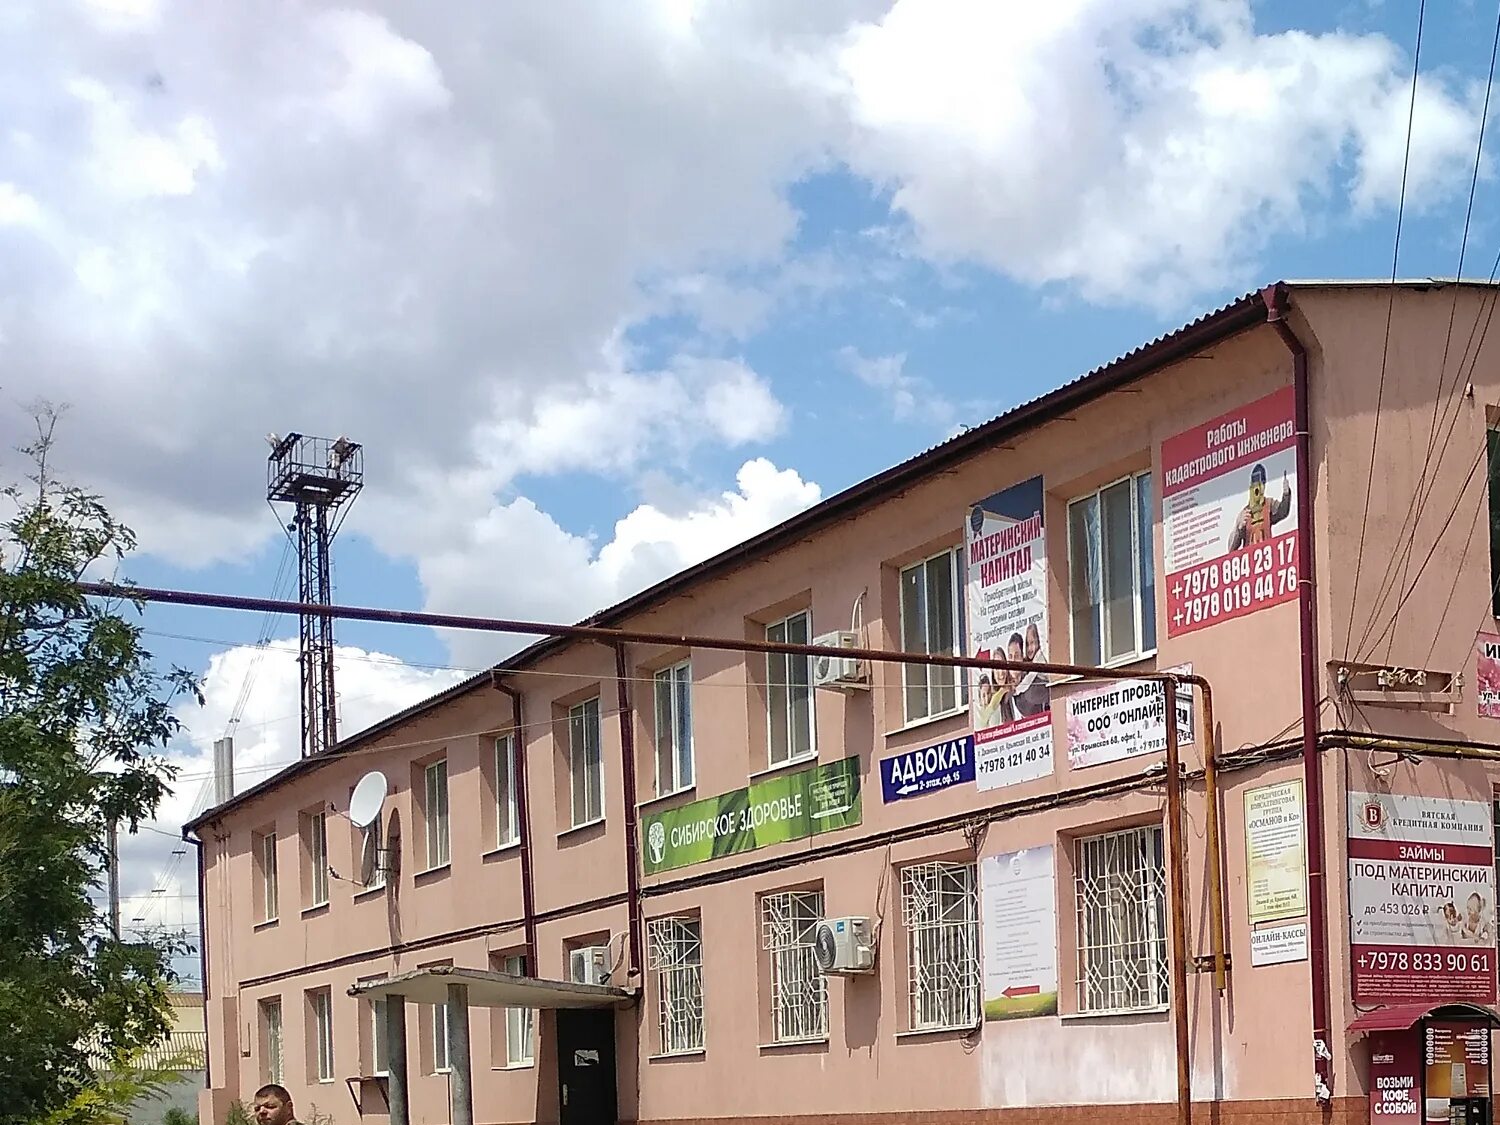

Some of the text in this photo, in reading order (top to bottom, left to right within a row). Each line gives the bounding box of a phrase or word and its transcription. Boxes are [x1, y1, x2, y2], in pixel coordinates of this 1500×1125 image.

[1206, 418, 1246, 448] Работы
[1237, 420, 1293, 458] инженера
[970, 511, 1041, 565] МАТЕРИНСКИЙ
[980, 545, 1032, 588] КАПИТАЛ
[1172, 536, 1295, 600] +7978 884 23 17
[1172, 566, 1297, 627] +7978 019 44 76
[1072, 691, 1120, 716] ИНТЕРНЕТ
[1482, 691, 1496, 701] ул.
[1088, 715, 1111, 733] ООО
[891, 738, 967, 785] АДВОКАТ
[979, 744, 1050, 773] +7978 121 40 34
[670, 811, 736, 848] СИБИРСКОЕ
[739, 794, 803, 831] ЗДОРОВЬЕ
[1392, 818, 1484, 832] КРЕДИТНАЯ КОМПАНИЯ
[1421, 811, 1456, 821] ВЯТСКАЯ
[1399, 845, 1445, 861] ЗАЙМЫ
[1354, 863, 1487, 884] ПОД МАТЕРИНСКИЙ
[1391, 882, 1454, 899] КАПИТАЛ
[1364, 906, 1377, 915] до
[1379, 903, 1399, 915] 453
[1401, 904, 1420, 916] 026
[1251, 929, 1306, 945] ОНЛАЙН-КАССЫ
[1357, 951, 1490, 972] +7978 833 90 61
[1376, 1076, 1414, 1089] ВОЗЬМИ
[1374, 1098, 1417, 1114] С СОБОЙ!
[1382, 1089, 1409, 1102] КОФЕ
